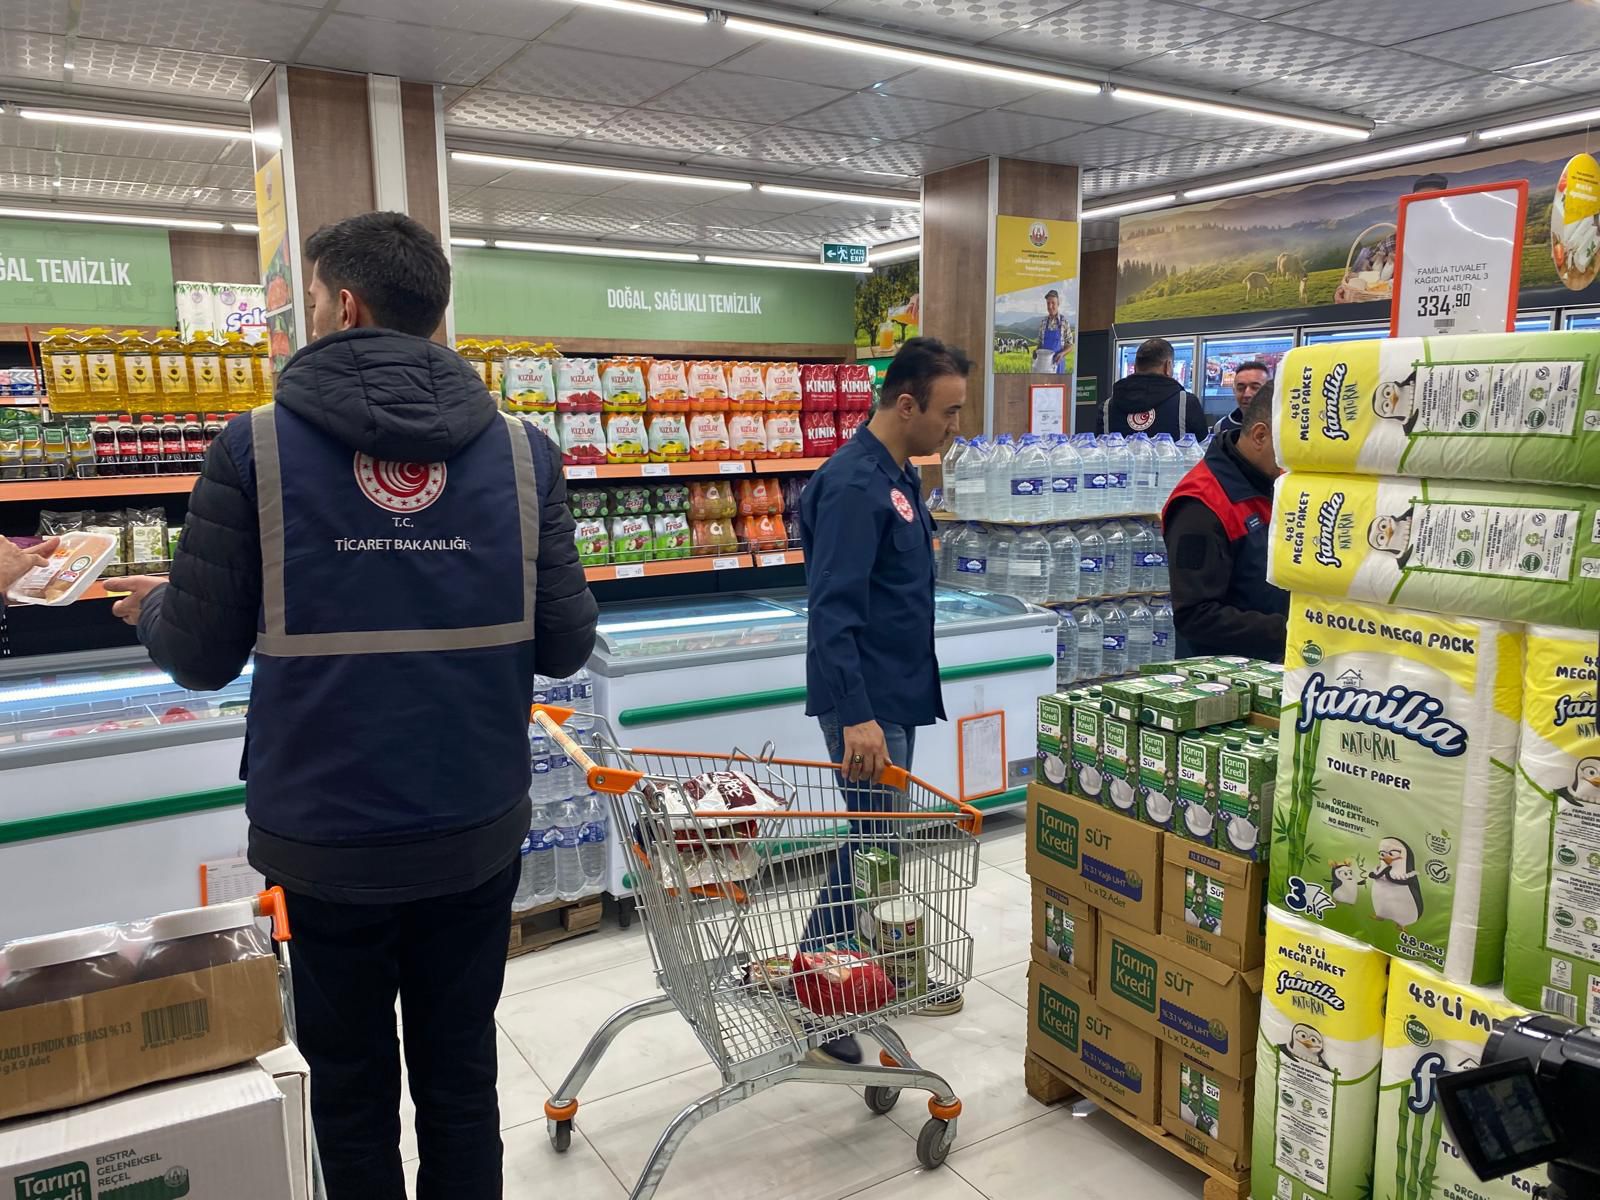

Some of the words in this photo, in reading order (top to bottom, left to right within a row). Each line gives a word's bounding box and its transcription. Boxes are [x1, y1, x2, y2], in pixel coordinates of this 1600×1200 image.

[36, 256, 131, 286] TEMİZLİK
[1443, 273, 1482, 282] NATURAL
[1450, 262, 1488, 272] TUVALET
[1428, 284, 1450, 292] KATLI
[1451, 283, 1472, 292] 48(T)
[607, 286, 652, 312] DOĞAL,
[654, 289, 706, 313] SAĞLIKLI
[708, 292, 762, 314] TEMİZLİK
[806, 380, 837, 392] KINIK
[841, 380, 872, 392] KINIK
[1302, 366, 1312, 404] PAKET
[1322, 363, 1350, 440] familia
[808, 426, 836, 440] KINIK
[1300, 408, 1310, 440] MEGA
[1296, 492, 1310, 528] PAKET
[392, 517, 414, 528] T.C.
[1315, 492, 1345, 568] familia
[335, 538, 392, 550] TİCARET
[394, 536, 467, 550] BAKANLIĞI
[1293, 532, 1304, 564] MEGA
[1305, 608, 1324, 624] 48
[1326, 614, 1376, 634] ROLLS
[1380, 624, 1423, 646] MEGA
[1428, 633, 1475, 654] PACK
[1556, 666, 1597, 680] MEGA
[1042, 712, 1058, 721] Kredi
[1078, 721, 1094, 731] Kredi
[1296, 672, 1469, 758] familia
[1040, 724, 1052, 734] Süt
[1076, 734, 1088, 744] Süt
[1108, 732, 1122, 742] Kredi
[1106, 745, 1118, 756] Süt
[1144, 743, 1161, 756] Kredi
[1341, 731, 1401, 762] NATURAL
[1143, 758, 1155, 768] Süt
[1184, 754, 1202, 766] Kredi
[1224, 766, 1244, 778] Kredi
[1182, 769, 1195, 780] Süt
[1327, 757, 1368, 778] TOILET
[1370, 770, 1410, 790] PAPER
[1224, 782, 1237, 792] Süt
[1316, 800, 1345, 816] BAMBOO
[1346, 811, 1380, 828] EXTRACT
[1332, 798, 1363, 814] ORGANIC
[1040, 807, 1076, 838] Tarım
[1041, 827, 1073, 856] Kredi
[1085, 828, 1112, 850] SÜT
[1286, 877, 1307, 909] 3
[1306, 904, 1323, 920] ply
[1400, 932, 1417, 946] 48
[1420, 942, 1443, 956] ROLLS
[1114, 944, 1154, 980] Tarım
[1278, 946, 1306, 964] MEGA
[1310, 958, 1346, 978] PAKET
[1116, 966, 1151, 999] Kredi
[1164, 970, 1194, 996] SÜT
[1276, 970, 1345, 1010] familia
[1041, 986, 1077, 1024] Tarım
[1043, 1008, 1074, 1038] Kredi
[1086, 1016, 1112, 1040] SÜT
[1194, 1026, 1209, 1038] UHT
[32, 1039, 65, 1056] FINDIK
[67, 1026, 108, 1048] KREMASI
[1162, 1026, 1166, 1036] 1
[1168, 1030, 1173, 1040] L
[1190, 1040, 1210, 1059] Adet
[28, 1056, 50, 1068] Adet
[95, 1148, 137, 1166] EKSTRA
[96, 1152, 162, 1176] GELENEKSEL
[19, 1169, 86, 1198] Tarım
[98, 1174, 131, 1188] REÇEL
